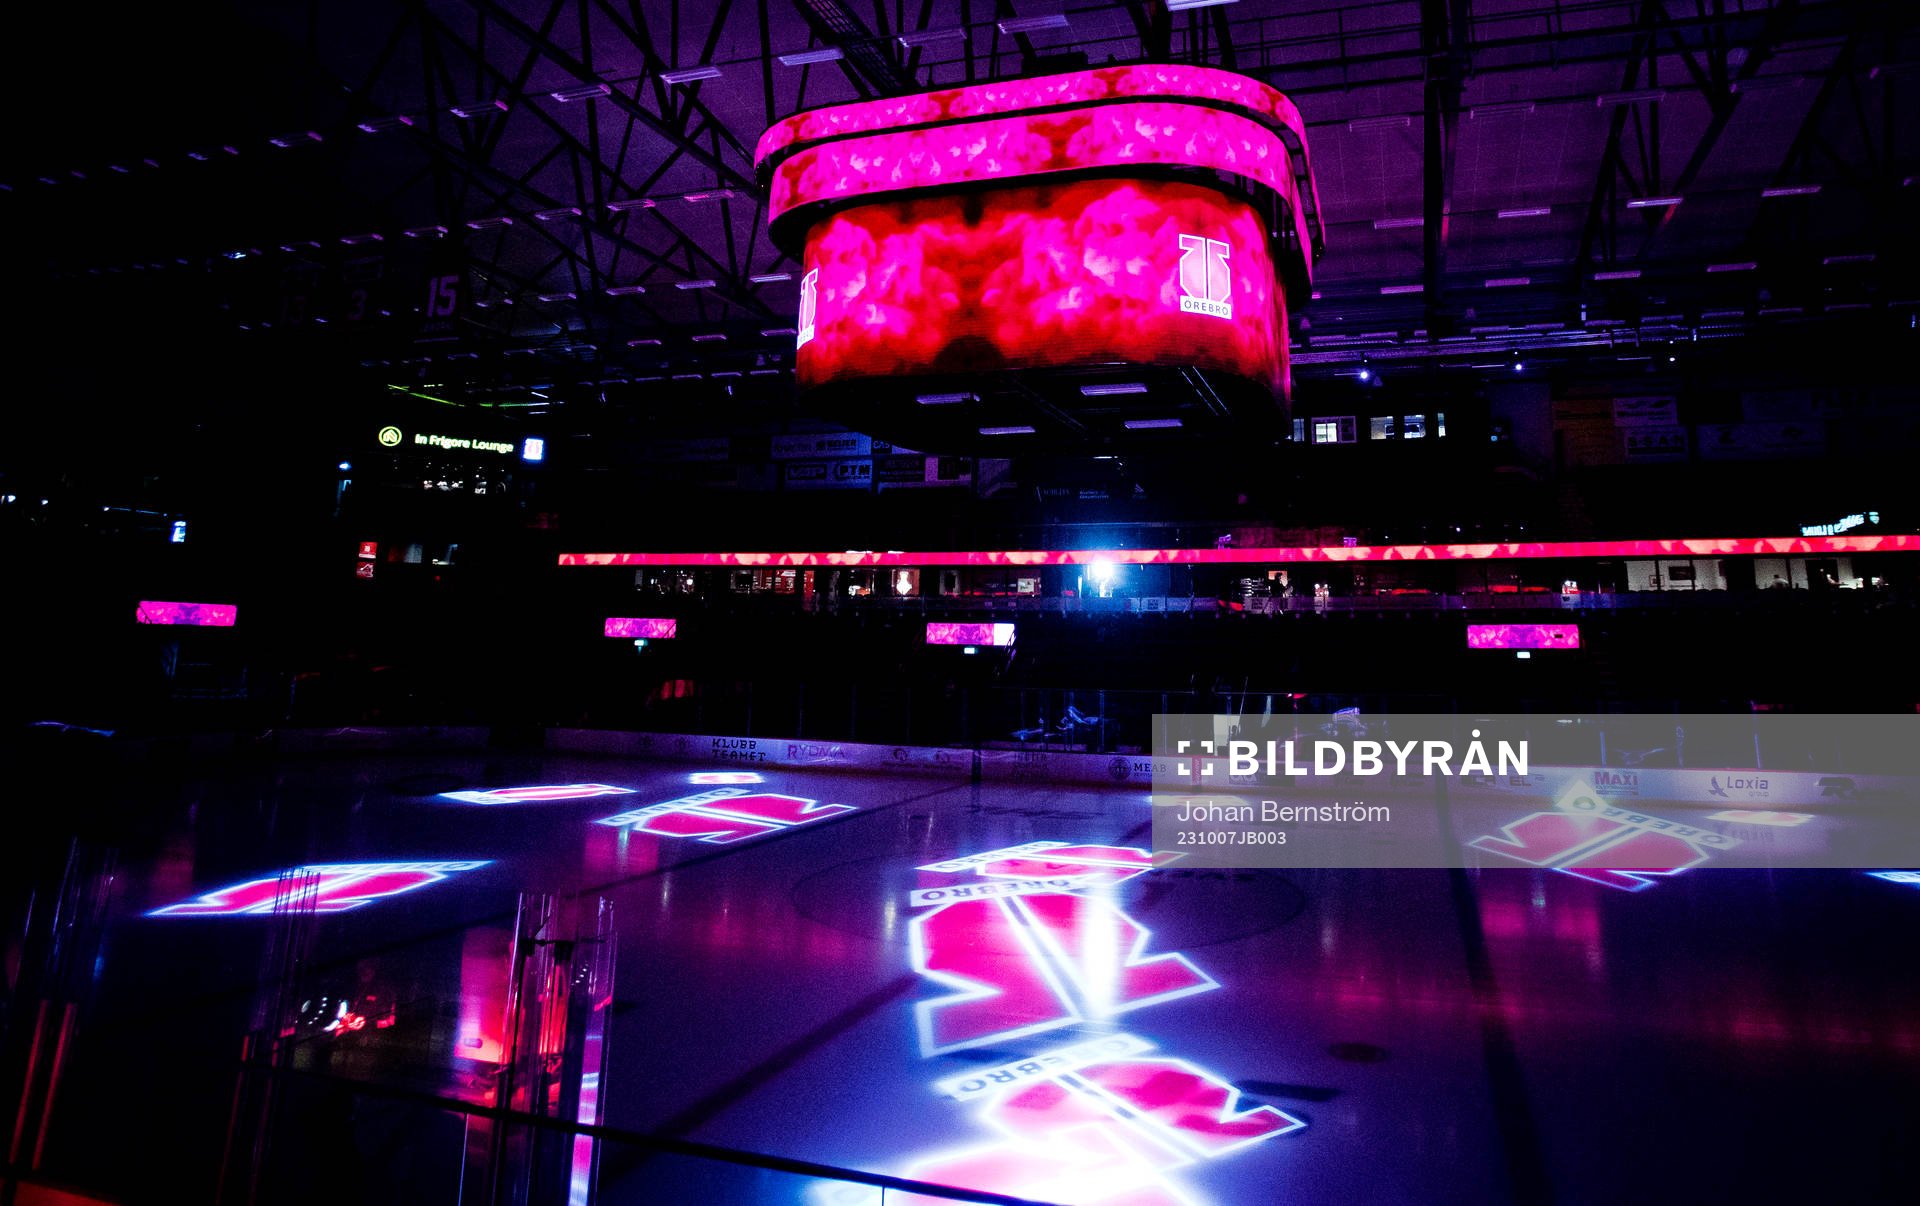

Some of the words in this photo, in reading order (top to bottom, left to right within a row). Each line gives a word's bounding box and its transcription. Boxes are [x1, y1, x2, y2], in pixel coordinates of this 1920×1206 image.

[426, 273, 461, 318] 15
[415, 434, 427, 444] In
[429, 435, 470, 449] Frigore
[472, 439, 514, 453] Lounge
[712, 738, 757, 750] KLUBB
[1727, 776, 1769, 790] Loxia
